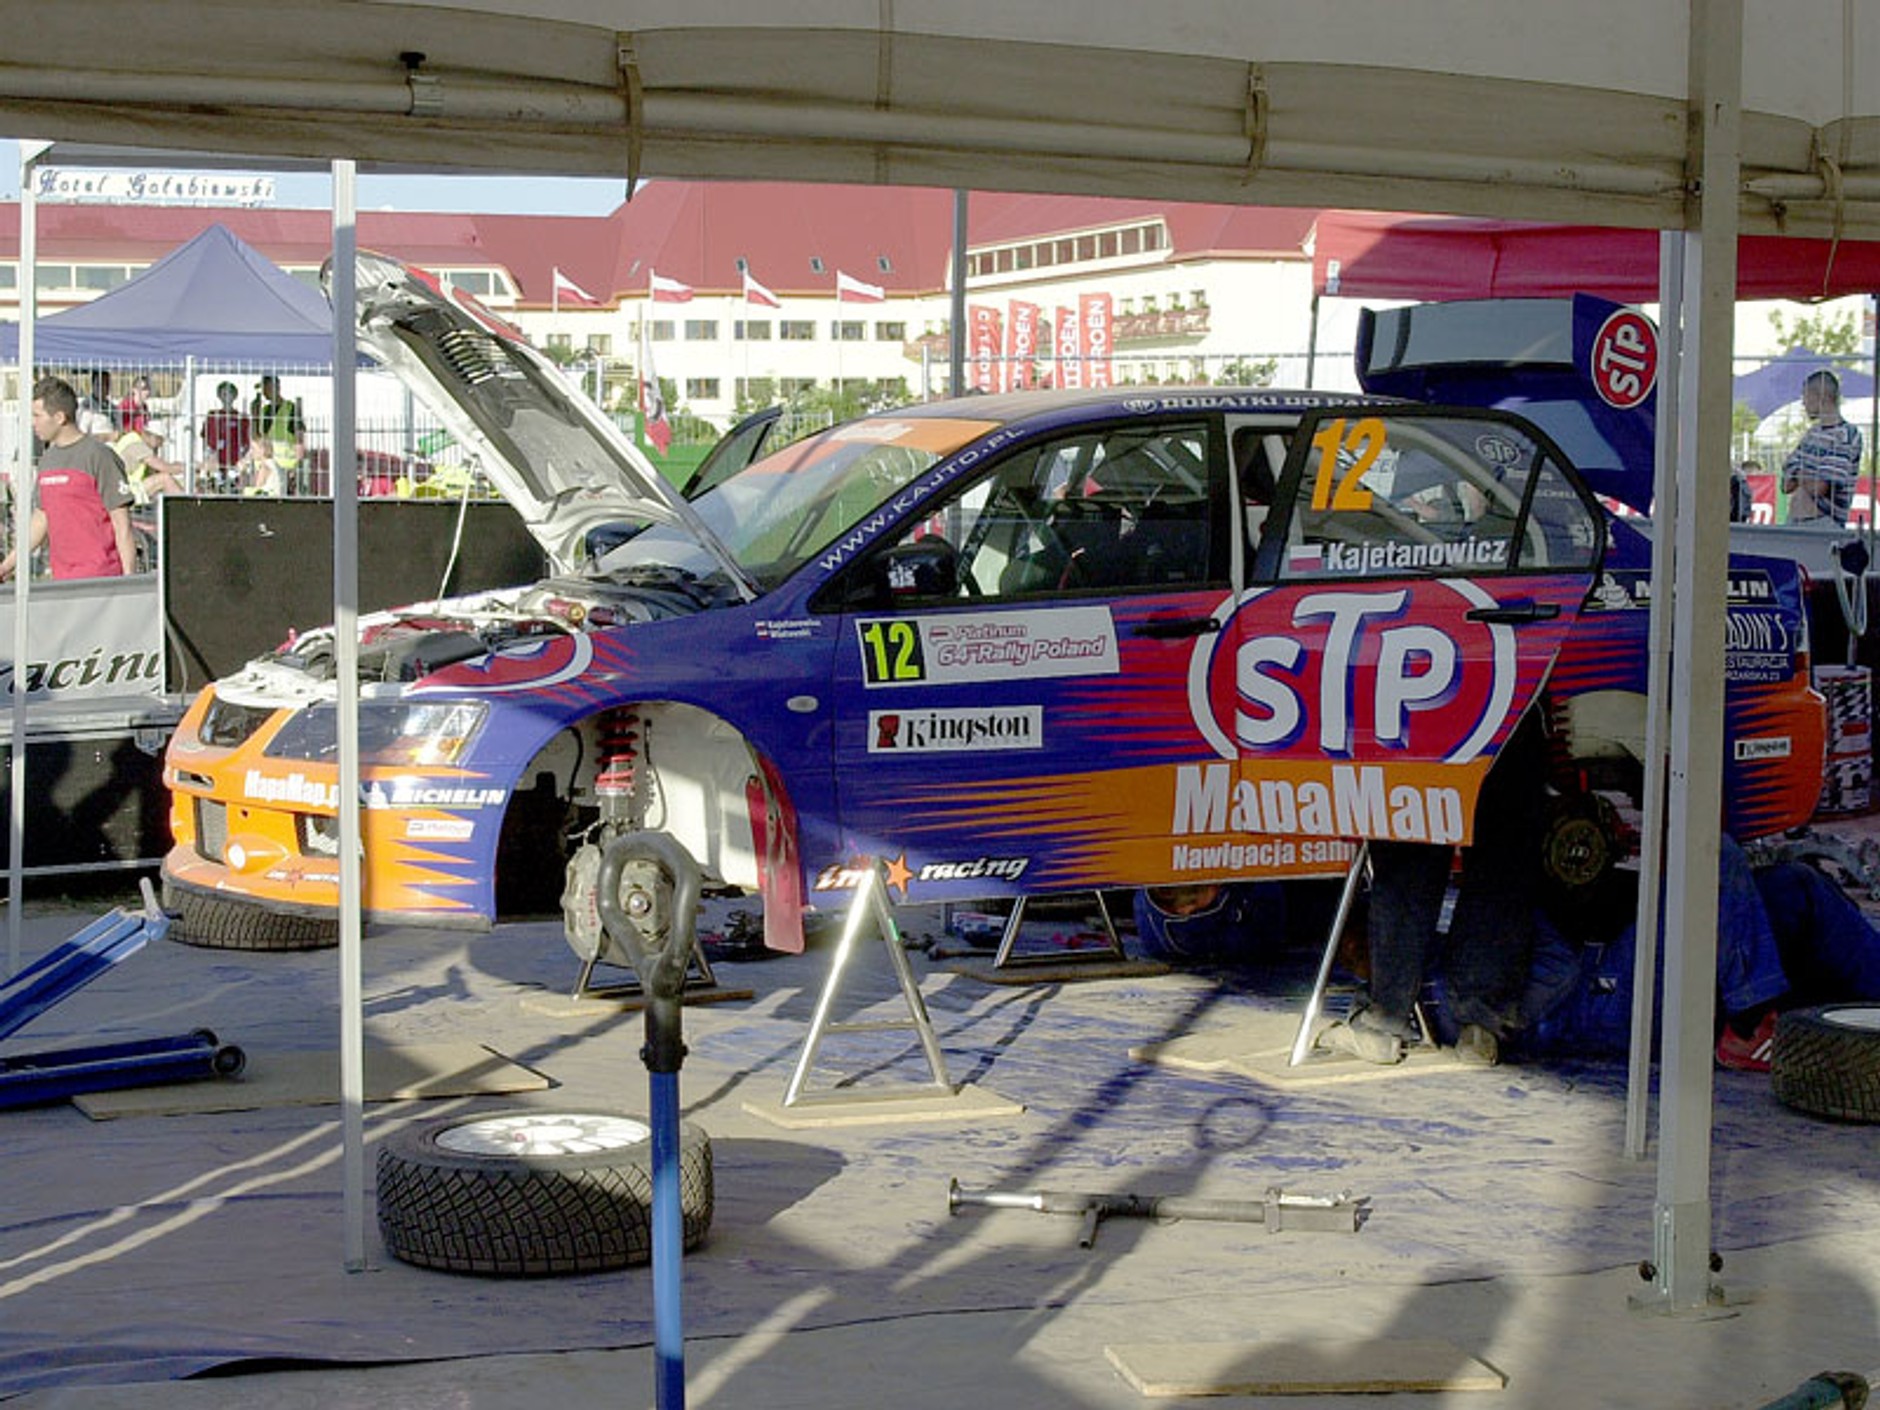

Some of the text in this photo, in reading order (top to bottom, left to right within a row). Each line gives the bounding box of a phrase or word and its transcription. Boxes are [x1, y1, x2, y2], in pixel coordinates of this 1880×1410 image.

[38, 169, 108, 196] Hotel
[1601, 323, 1646, 397] STP
[1311, 417, 1387, 511] 12
[1327, 536, 1507, 575] Kajetanowicz
[956, 624, 1028, 640] Platinum
[864, 622, 920, 680] 12
[976, 641, 1029, 666] Rally
[1032, 635, 1106, 660] Poland
[1234, 589, 1458, 752] STP
[907, 713, 1031, 746] Kingston
[391, 788, 506, 805] MICHELIN
[1172, 762, 1464, 844] MapaMap
[919, 857, 1028, 881] racing
[1172, 841, 1295, 871] Nawigacja
